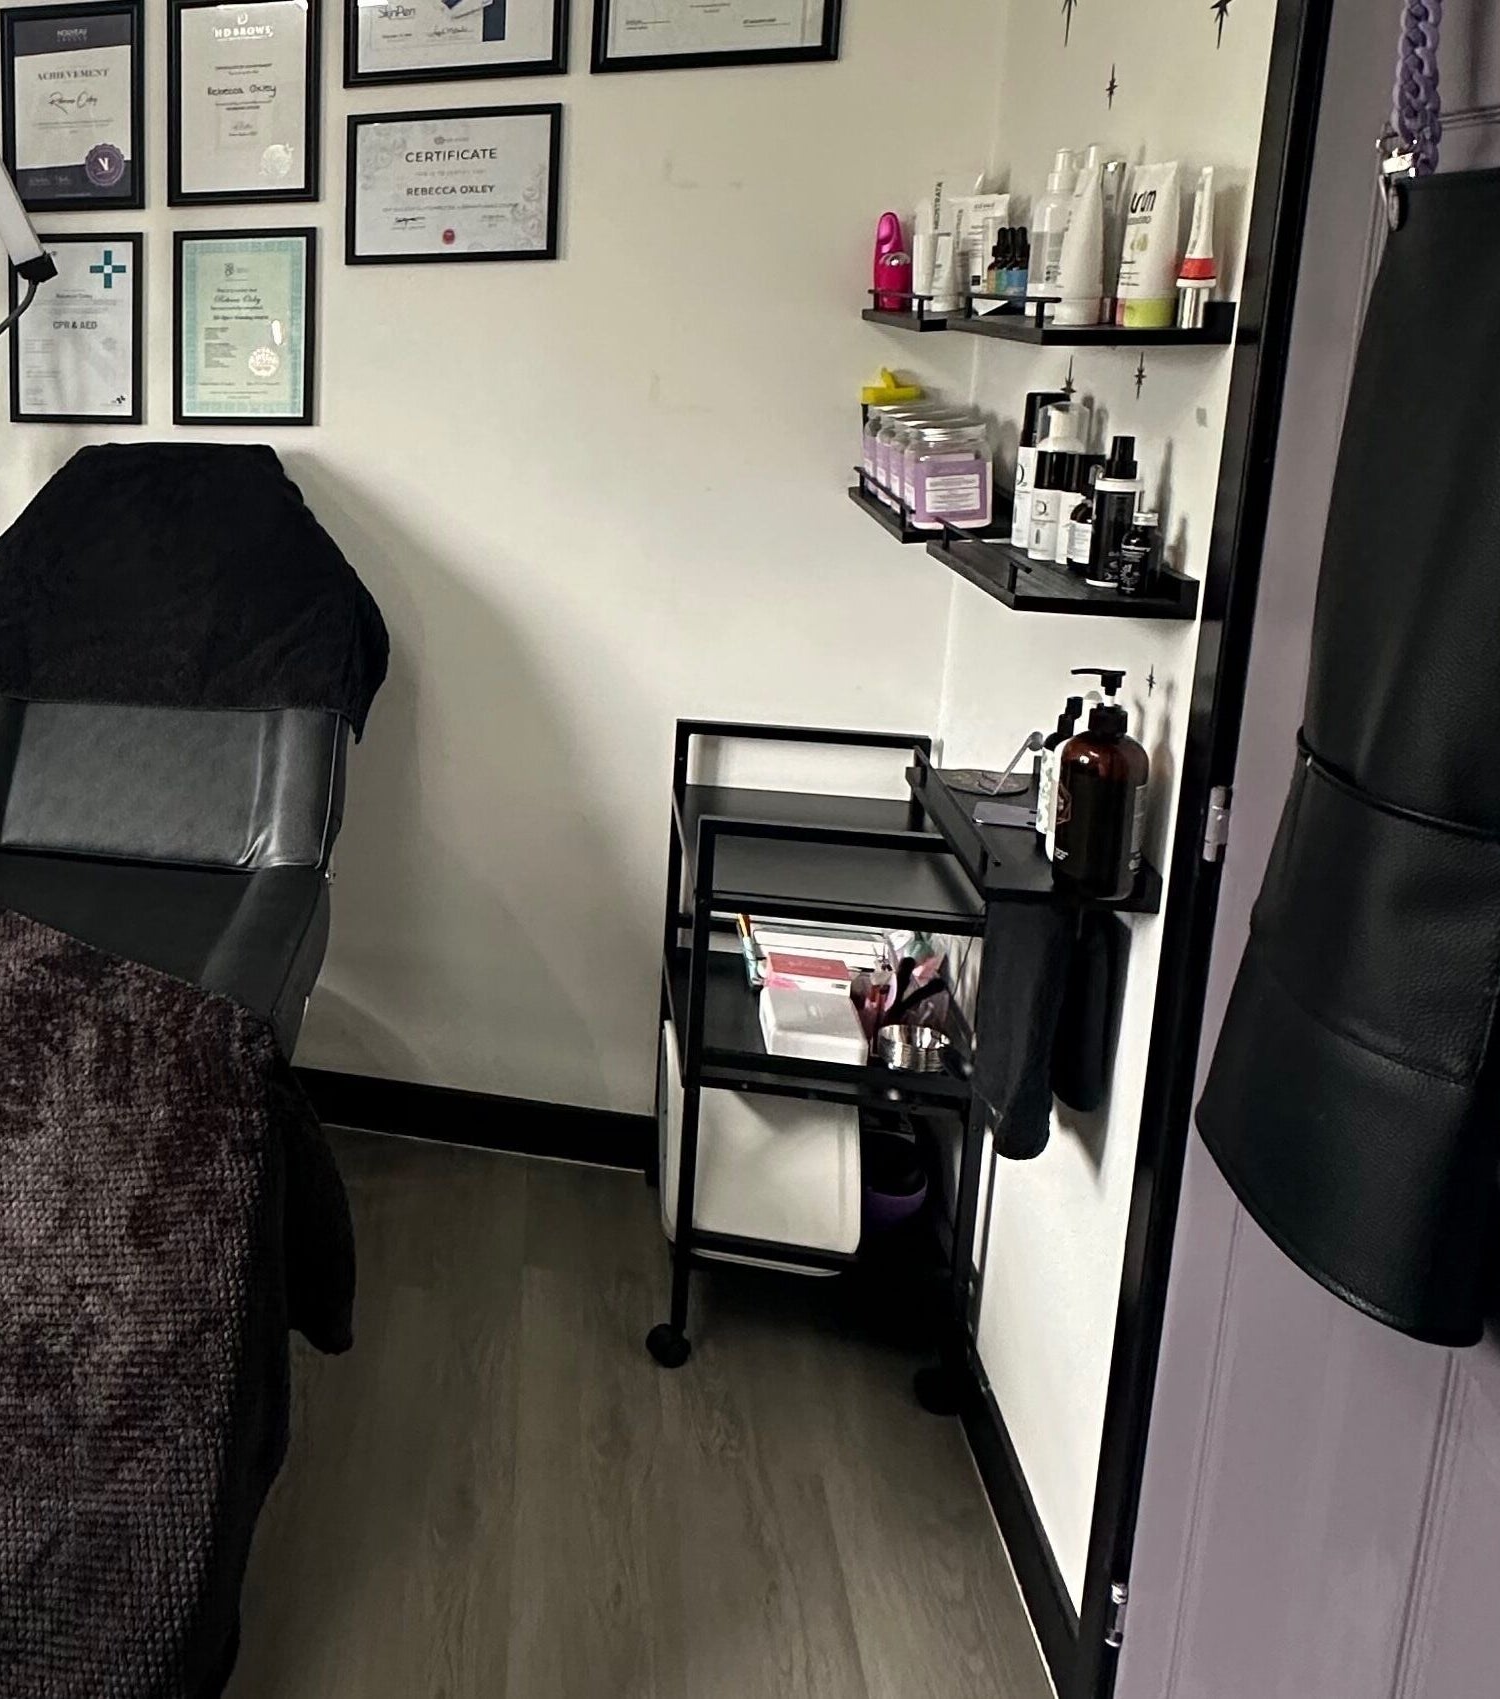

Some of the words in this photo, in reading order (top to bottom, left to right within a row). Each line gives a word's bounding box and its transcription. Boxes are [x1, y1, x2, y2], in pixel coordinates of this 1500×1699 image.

[37, 68, 109, 81] ACHIEVEMENT
[405, 147, 497, 163] CERTIFICATE
[406, 186, 457, 197] REBECCA
[460, 184, 495, 194] OXLEY
[71, 321, 78, 329] &
